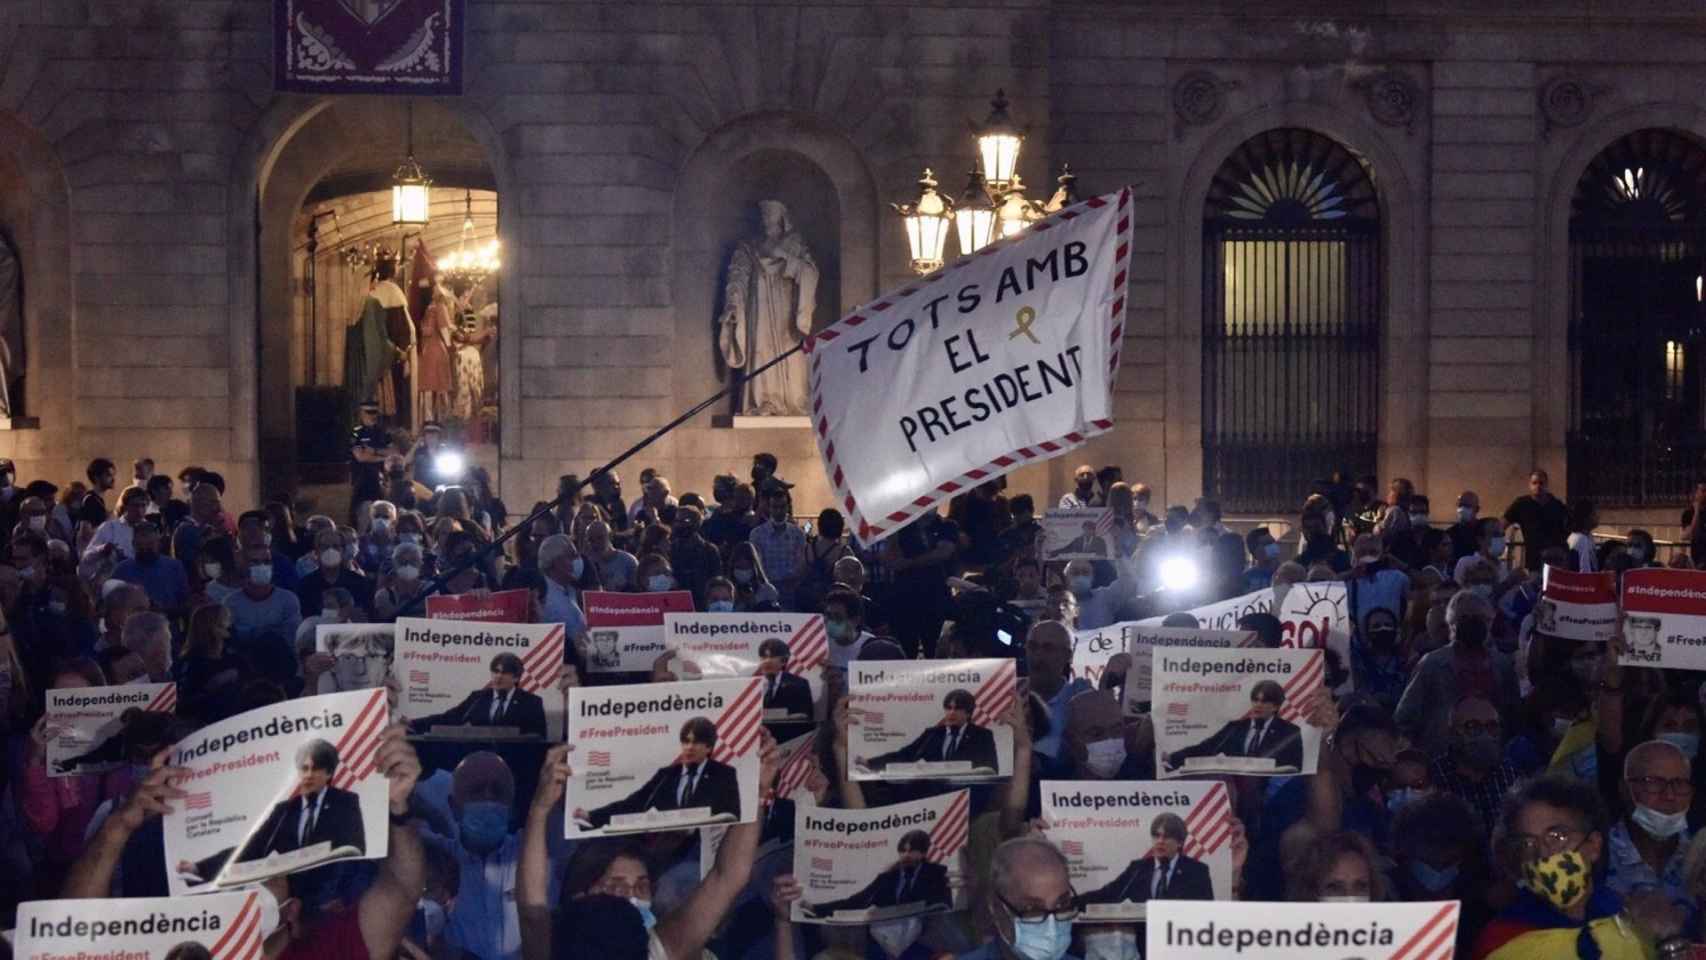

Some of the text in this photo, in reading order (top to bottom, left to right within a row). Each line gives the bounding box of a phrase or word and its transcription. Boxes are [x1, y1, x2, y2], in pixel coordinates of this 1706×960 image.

[848, 241, 1089, 373] TOTS AMB
[944, 329, 989, 373] EL
[900, 346, 1081, 452] PRESIDENT
[404, 627, 530, 648] Independència
[674, 621, 792, 637] Independència
[1089, 631, 1113, 653] de
[403, 650, 480, 664] #FreePresident
[1163, 657, 1292, 676] Independència
[53, 692, 150, 708] Independència
[580, 691, 724, 718] Independència
[177, 709, 344, 767] Independència
[579, 724, 670, 739] #FreePresident
[1052, 791, 1191, 811] Independència
[804, 808, 937, 835] Independència
[804, 838, 889, 850] #FreePresident
[30, 910, 221, 942] Independència
[1166, 921, 1394, 952] Independència
